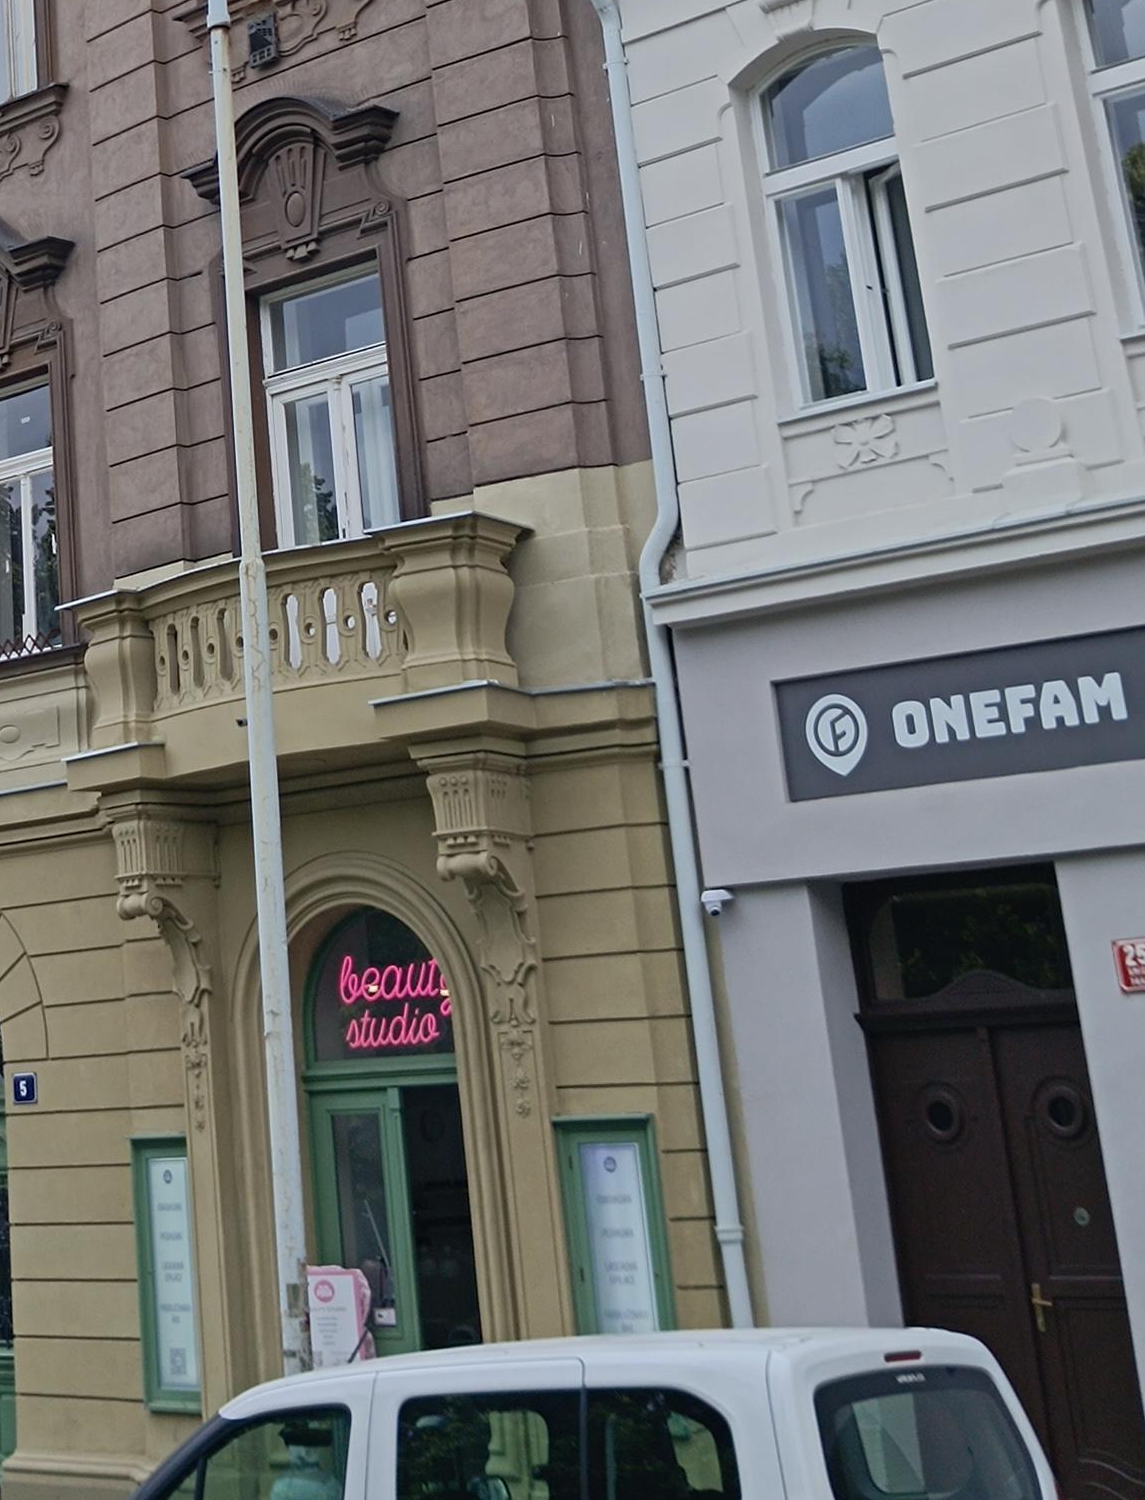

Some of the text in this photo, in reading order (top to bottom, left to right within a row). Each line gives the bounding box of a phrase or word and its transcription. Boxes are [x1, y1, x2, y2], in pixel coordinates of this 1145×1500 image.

[891, 671, 1128, 749] ONEFAM
[345, 1002, 440, 1048] studio
[19, 1080, 27, 1097] 5
